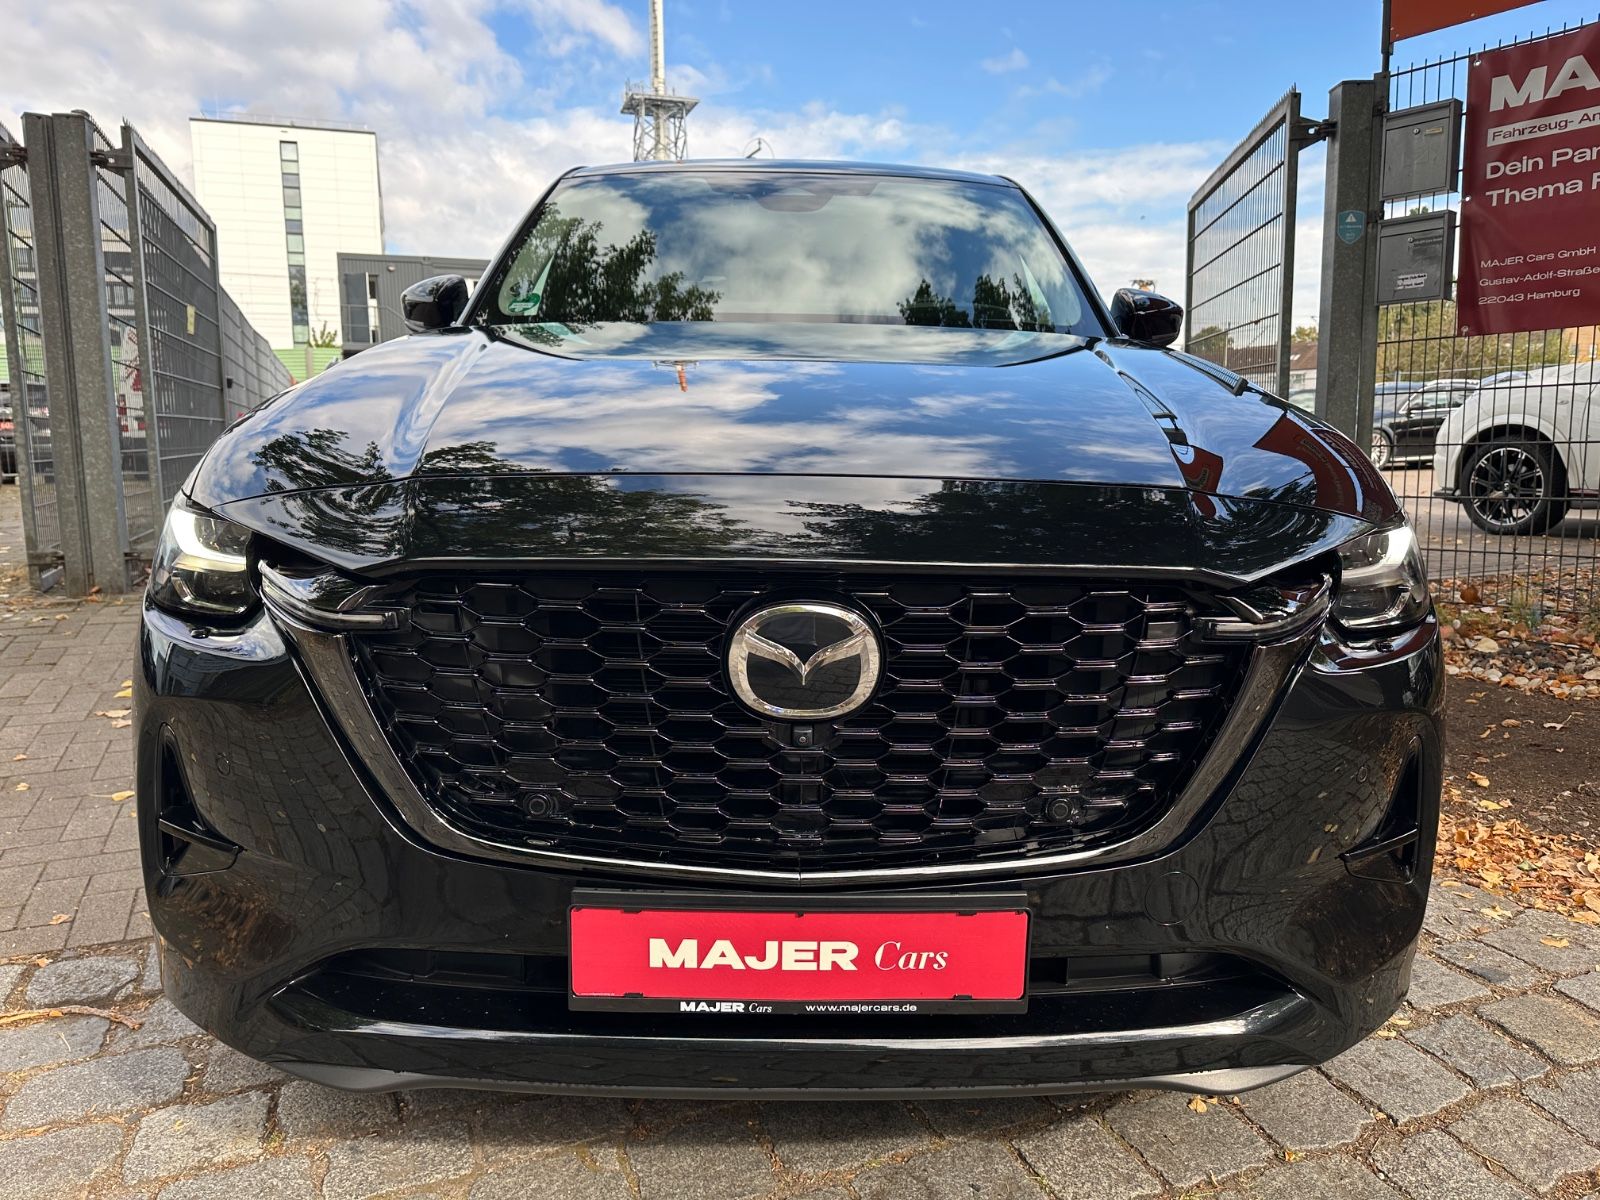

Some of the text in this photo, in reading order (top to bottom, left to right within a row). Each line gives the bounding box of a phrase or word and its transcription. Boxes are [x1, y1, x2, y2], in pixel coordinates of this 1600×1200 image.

[1489, 54, 1600, 113] MA
[1492, 119, 1574, 142] Fahrzeug-
[1486, 155, 1544, 180] Dein
[1485, 179, 1583, 207] Thema
[1480, 245, 1597, 268] MAJER Cars GmbH
[1479, 266, 1600, 287] Gustav-Adolf-Straße
[1478, 288, 1580, 305] 22043 Hamburg
[649, 938, 949, 971] MAJER Cars
[680, 1001, 918, 1014] MAJER Cars www.majercars.de
